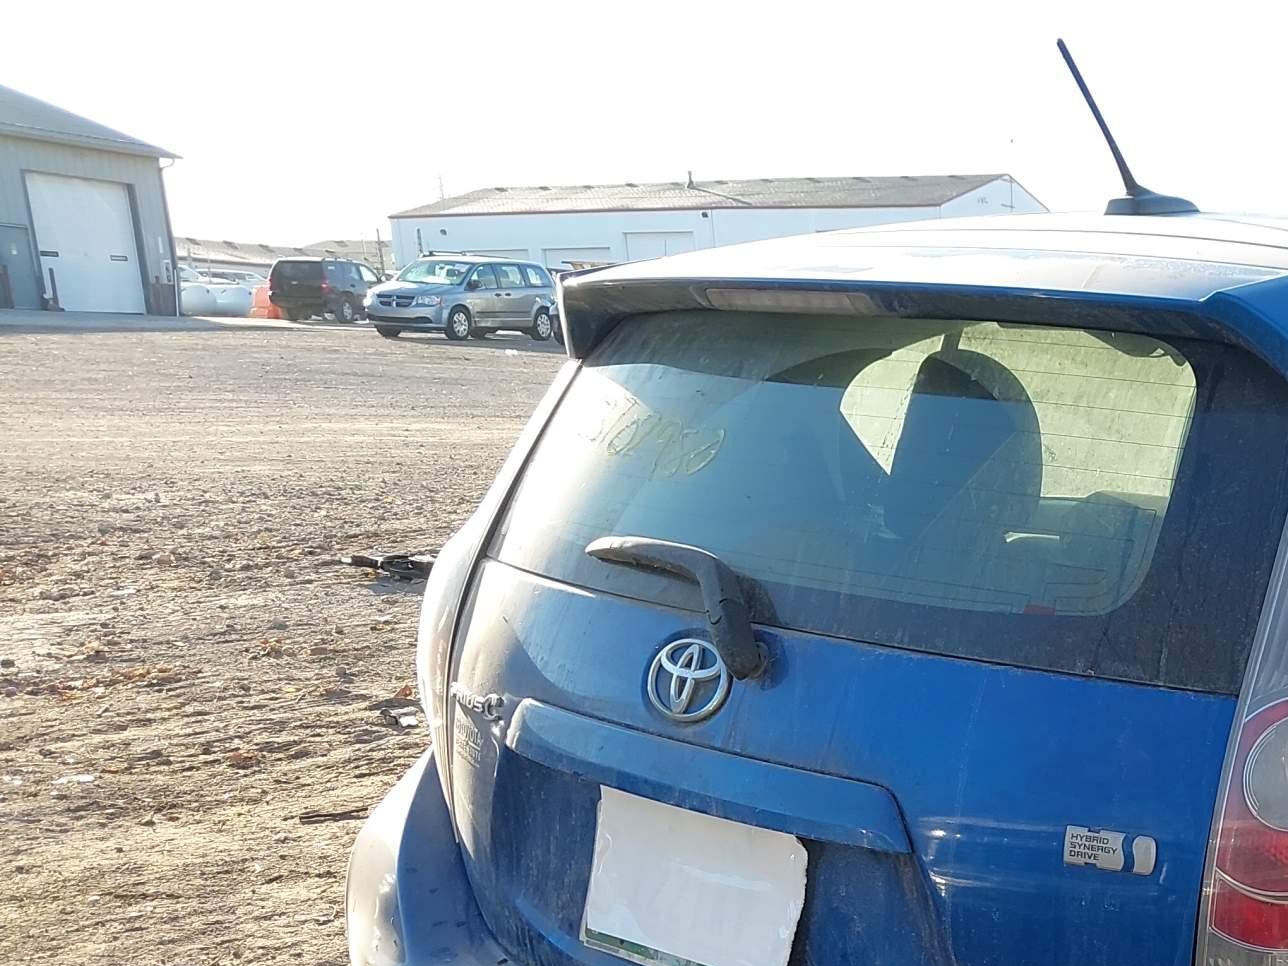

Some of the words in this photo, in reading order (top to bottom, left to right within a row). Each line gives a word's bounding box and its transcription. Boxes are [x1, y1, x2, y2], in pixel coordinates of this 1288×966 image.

[451, 681, 484, 713] PRIUS
[1070, 832, 1110, 845] HYBRID
[1069, 841, 1118, 855] SYNERGY
[1069, 849, 1101, 861] DRIVE
